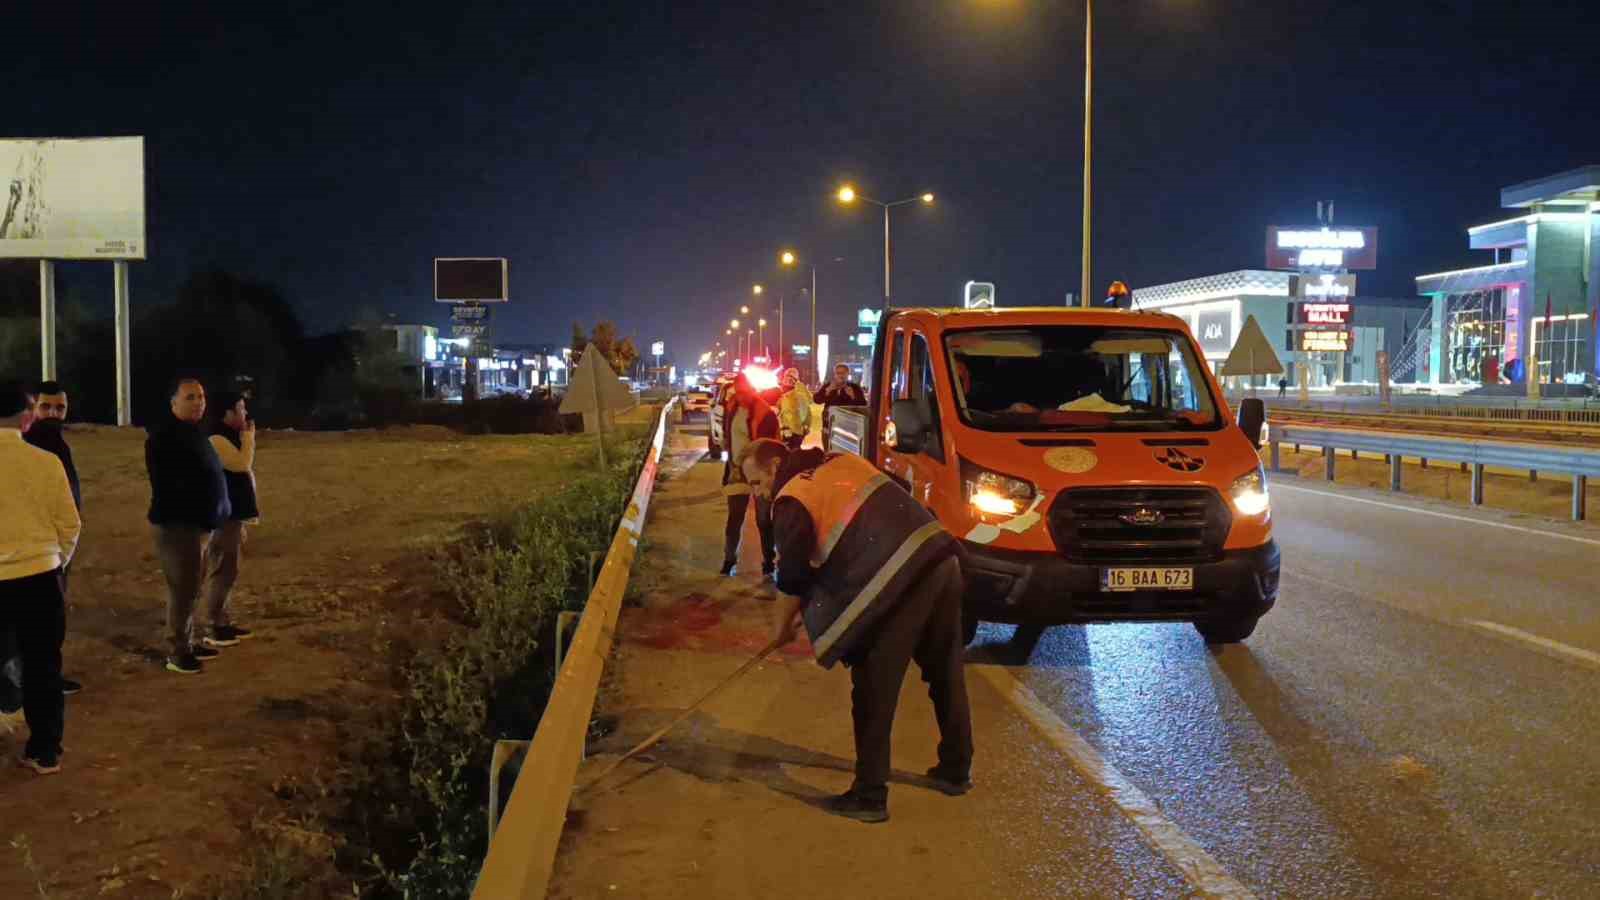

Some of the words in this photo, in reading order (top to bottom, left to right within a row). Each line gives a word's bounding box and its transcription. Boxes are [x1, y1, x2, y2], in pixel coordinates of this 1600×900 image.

[1308, 311, 1345, 323] MALL
[1111, 570, 1125, 585] 16
[1132, 570, 1158, 585] BAA
[1164, 570, 1190, 585] 673
